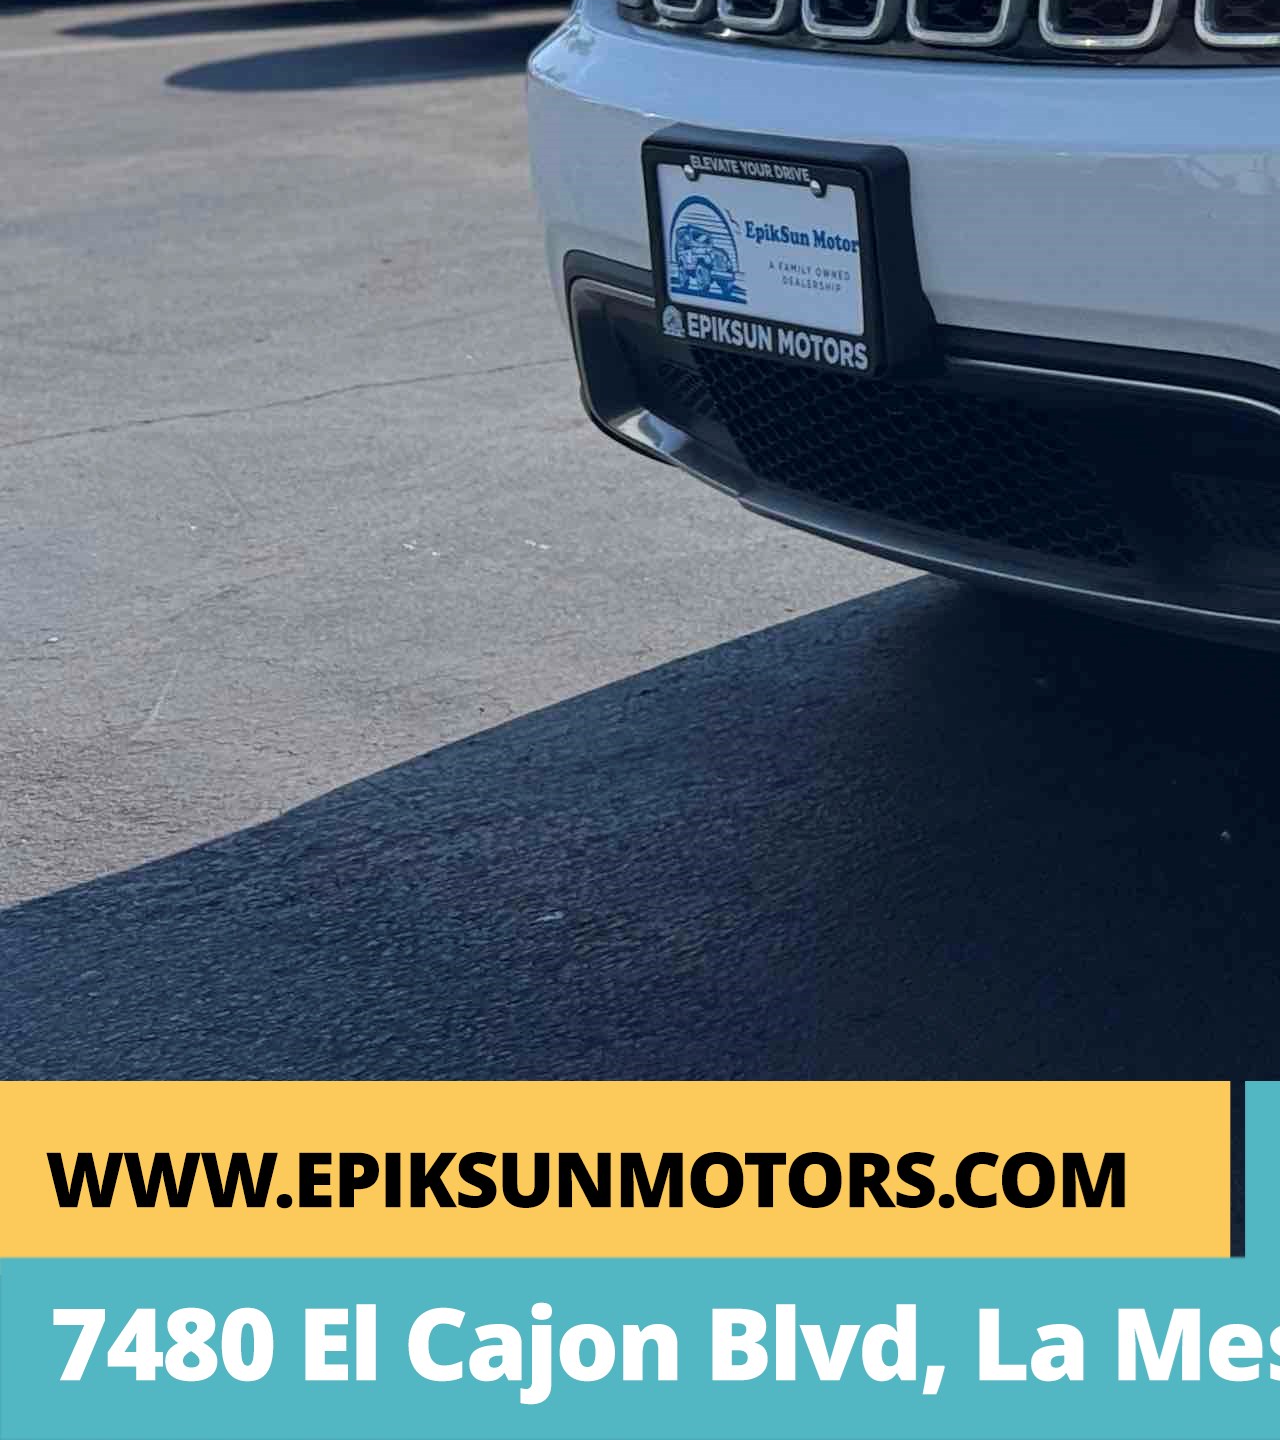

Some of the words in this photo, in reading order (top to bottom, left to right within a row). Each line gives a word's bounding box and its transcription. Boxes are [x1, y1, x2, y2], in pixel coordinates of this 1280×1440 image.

[690, 155, 739, 173] ELEVATE
[740, 159, 774, 178] YOUR
[775, 164, 811, 183] DRIVE
[744, 220, 811, 249] EpikSun
[812, 229, 860, 254] Motor
[778, 262, 812, 278] FAMILY
[815, 265, 851, 281] OWNED
[782, 276, 842, 294] DEALERSHIP
[687, 311, 773, 353] EPIKSUN
[778, 332, 869, 371] MOTORS
